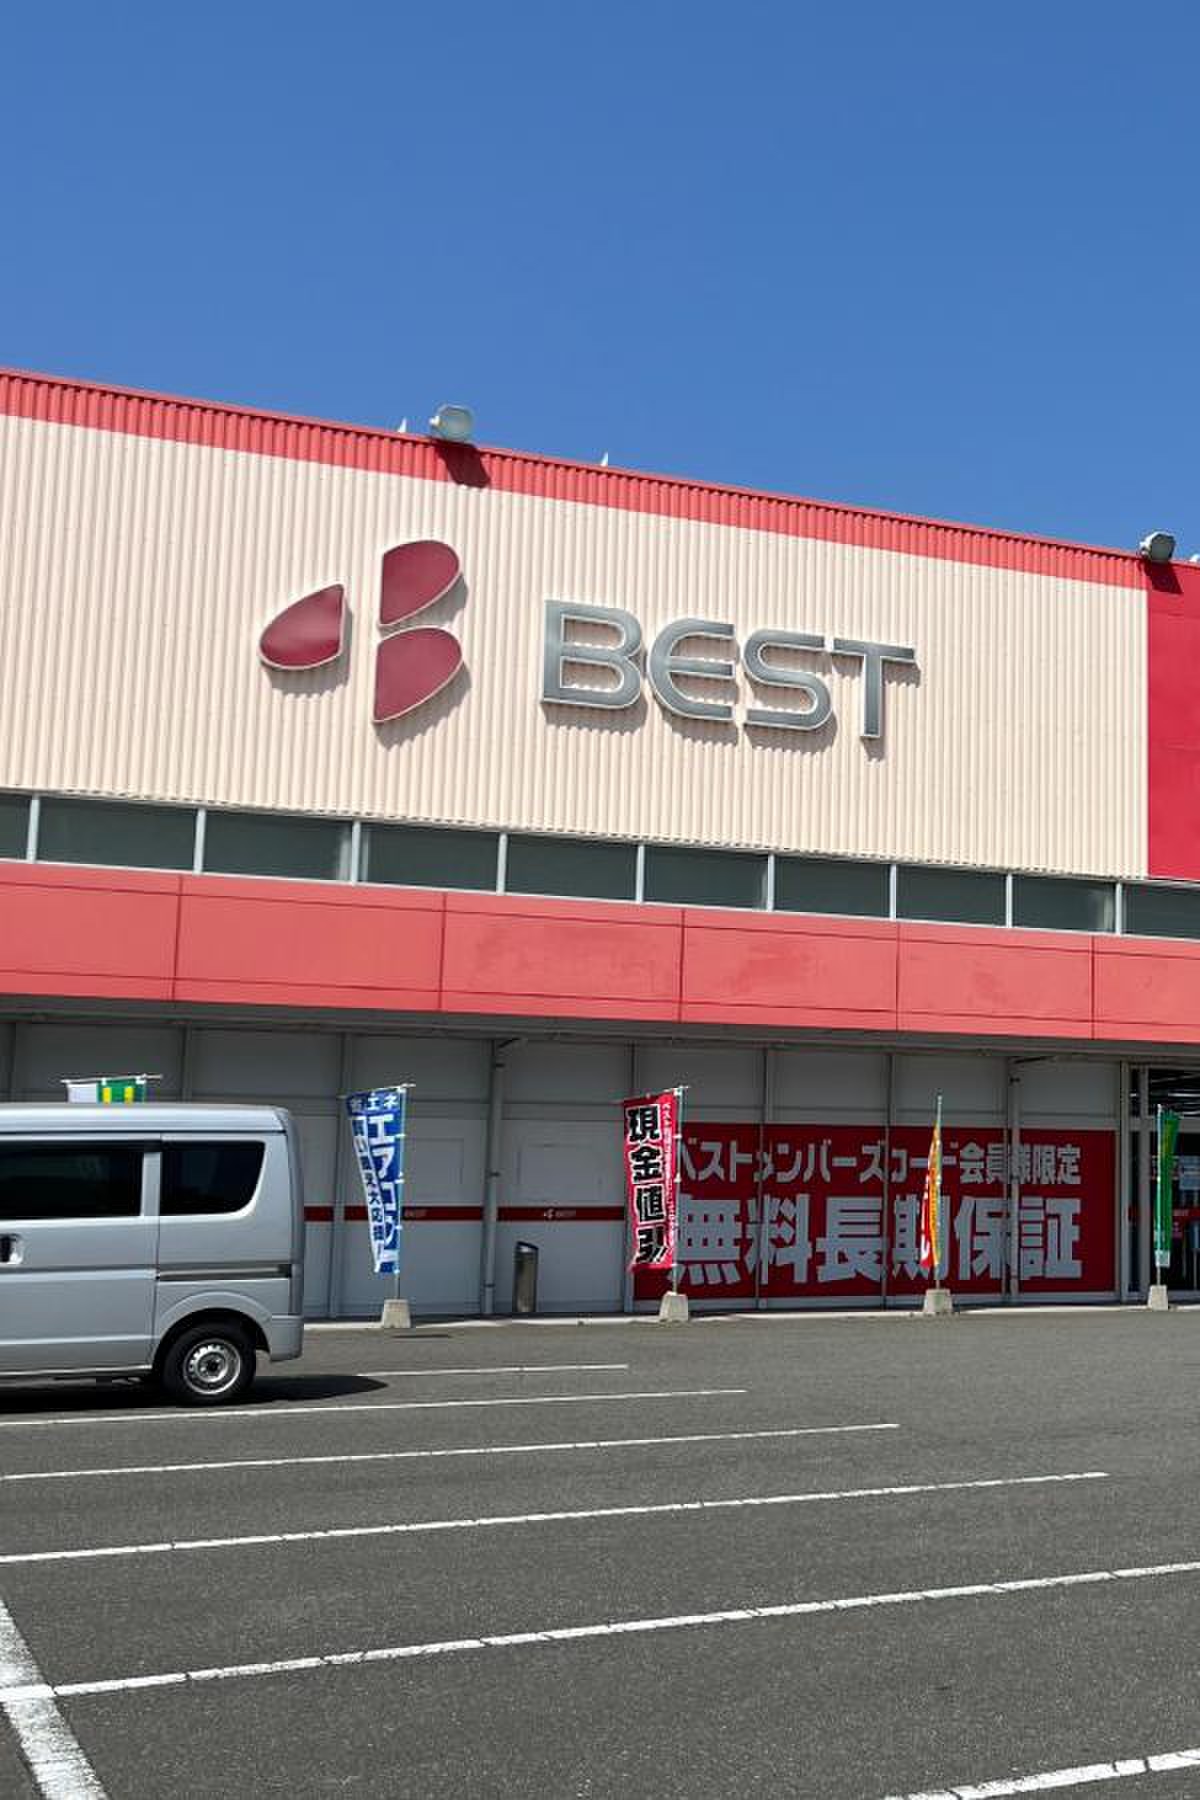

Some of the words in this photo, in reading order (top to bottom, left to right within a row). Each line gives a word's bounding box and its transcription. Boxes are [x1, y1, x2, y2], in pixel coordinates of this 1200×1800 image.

[541, 598, 917, 738] BEST
[367, 1113, 398, 1247] エアコン
[668, 1193, 1082, 1285] 無料長期保証
